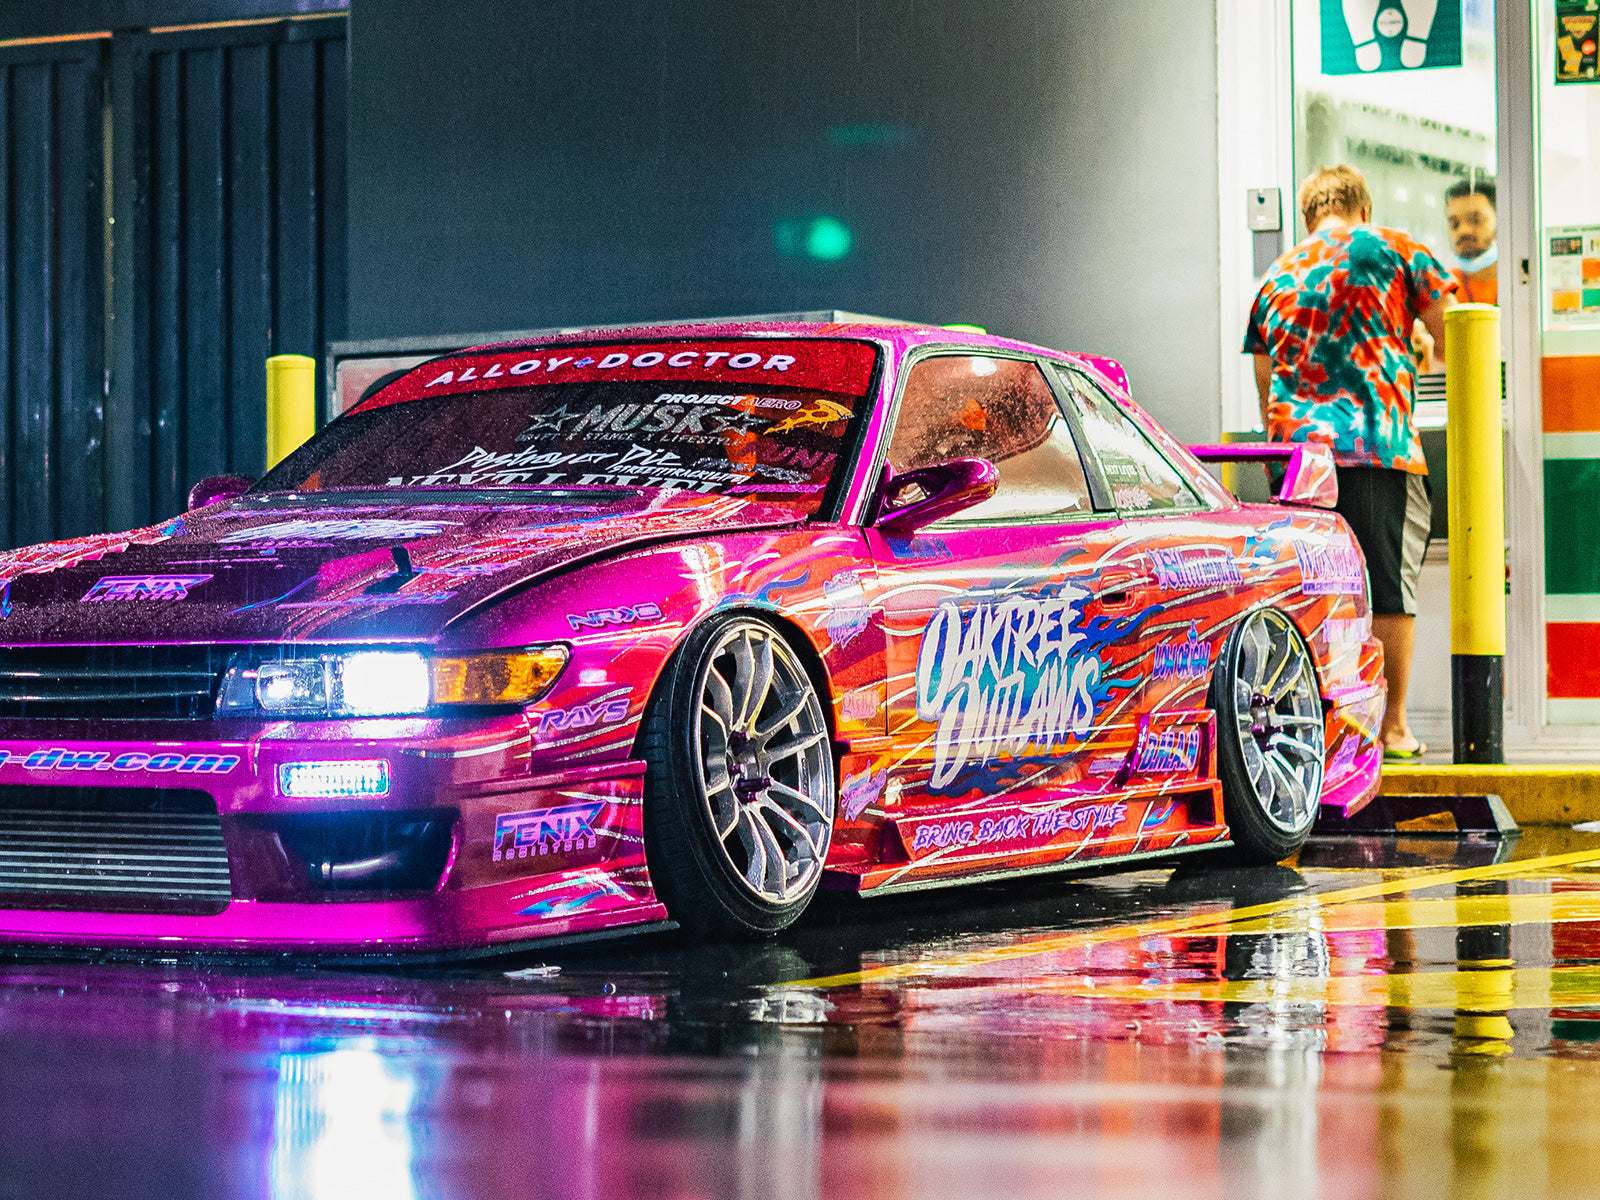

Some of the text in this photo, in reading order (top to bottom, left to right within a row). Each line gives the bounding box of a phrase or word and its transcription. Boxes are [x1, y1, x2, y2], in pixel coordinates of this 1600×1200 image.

[425, 351, 796, 388] ALLOY DOCTOR
[653, 393, 748, 406] PROJECT
[571, 403, 721, 435] MUSK
[582, 431, 639, 442] STANCE
[918, 580, 1091, 717] OAKTREE
[537, 698, 631, 734] RAYS
[930, 652, 1101, 789] OUTLAWS
[494, 800, 607, 850] FENIX
[912, 803, 1129, 850] BRING BACK THE STYLE
